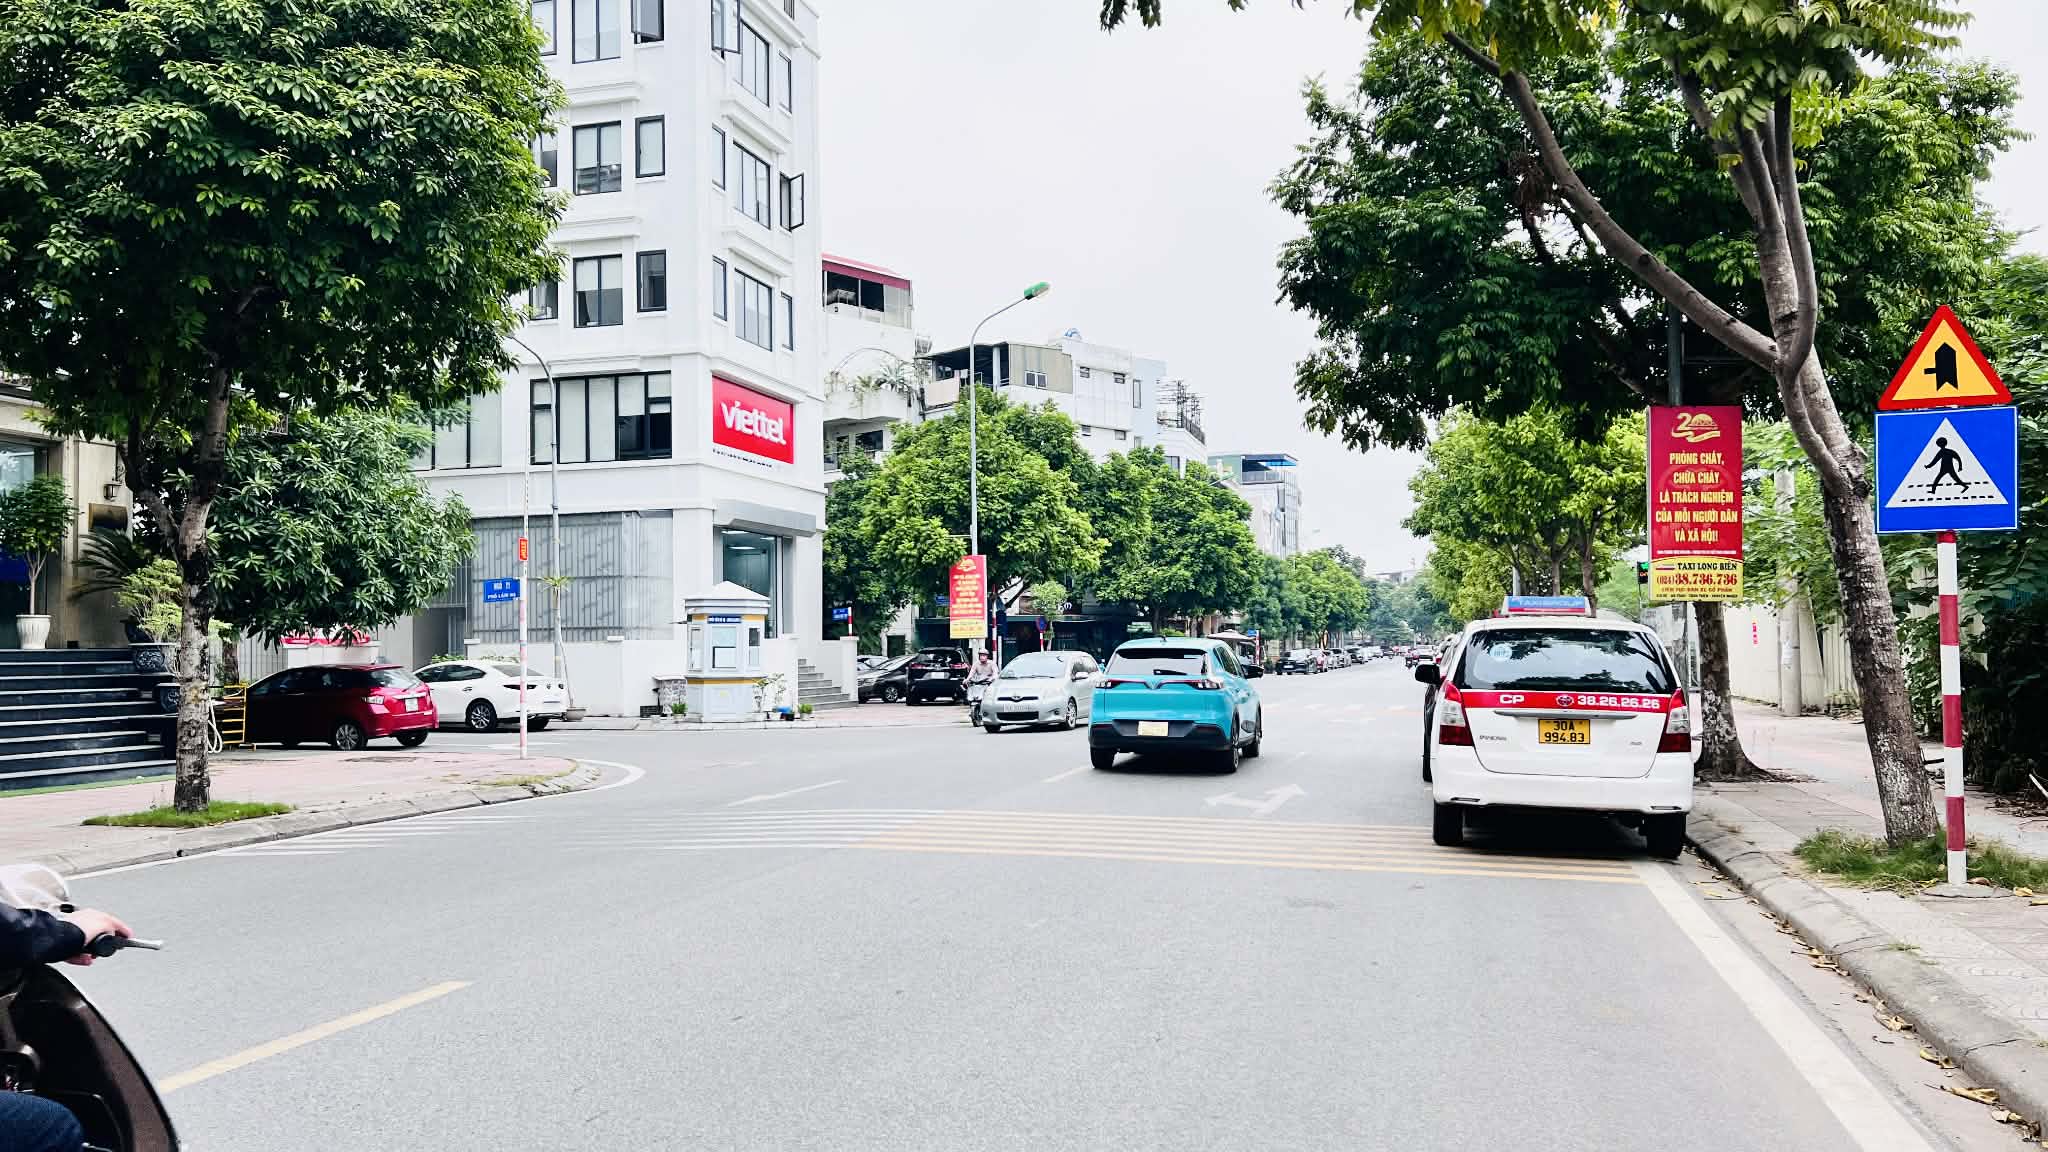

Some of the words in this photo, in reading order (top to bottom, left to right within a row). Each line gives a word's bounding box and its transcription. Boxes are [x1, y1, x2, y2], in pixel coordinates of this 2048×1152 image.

[1669, 450, 1698, 465] PHÒNG
[1700, 450, 1725, 466] CHÁY,
[1673, 470, 1696, 484] CHỮA
[1698, 470, 1720, 484] CHÁY
[1660, 489, 1671, 503] LÀ
[1672, 489, 1699, 503] TRÁCH
[1701, 489, 1734, 505] NGHIỆM
[1655, 507, 1673, 523] CỦA
[1674, 507, 1691, 523] MỖI
[1692, 508, 1719, 523] NGƯỜI
[1720, 508, 1738, 523] DÂN
[1675, 528, 1686, 542] VÀ
[1688, 528, 1699, 542] XÃ
[1677, 562, 1696, 571] TAXI
[1697, 562, 1718, 571] LONG
[1719, 560, 1737, 571] BIÊN
[1500, 694, 1525, 705] CP
[1577, 695, 1660, 709] 38.26.26.26
[1553, 720, 1575, 731] 30A
[1544, 732, 1585, 743] 994.83
